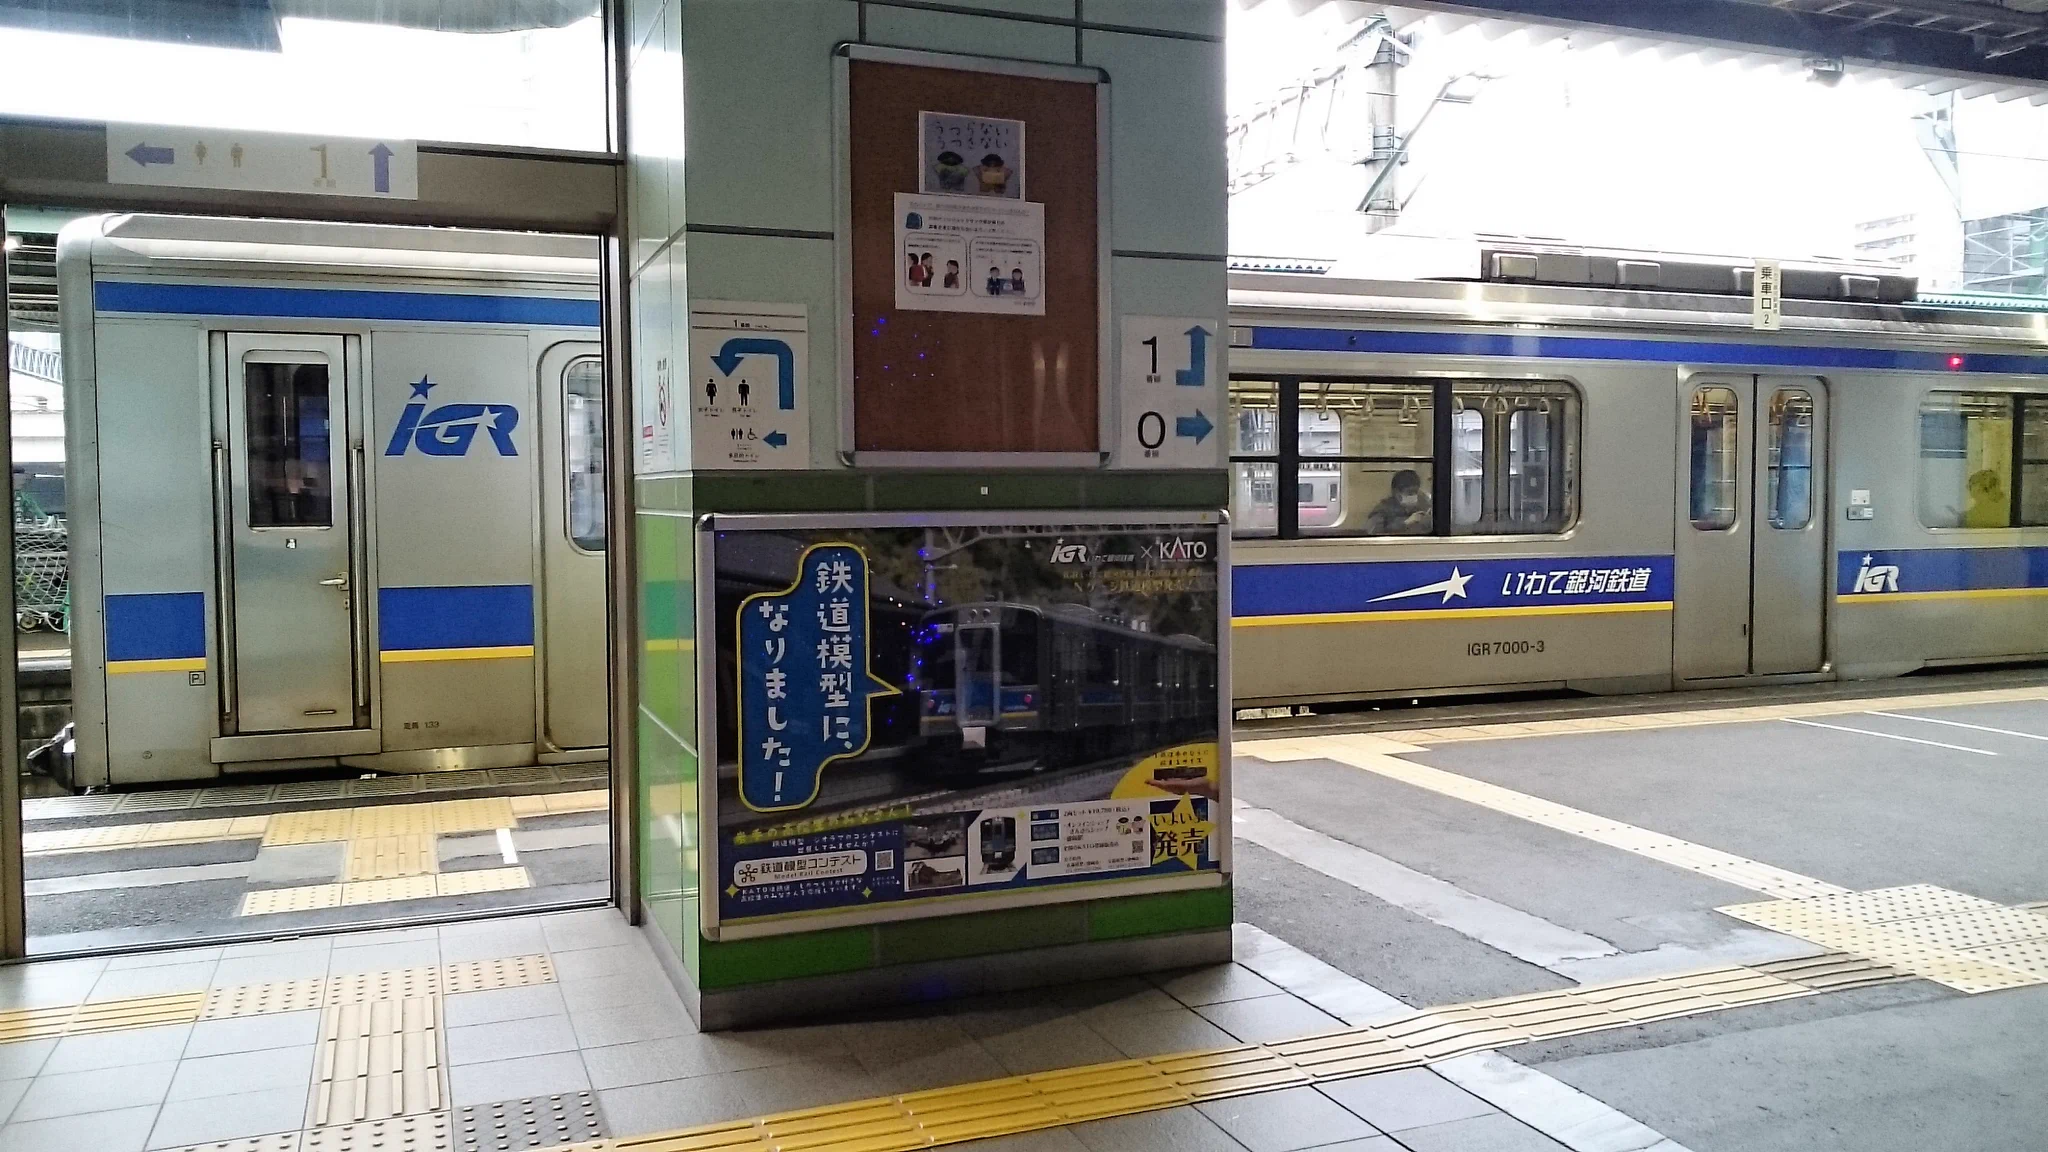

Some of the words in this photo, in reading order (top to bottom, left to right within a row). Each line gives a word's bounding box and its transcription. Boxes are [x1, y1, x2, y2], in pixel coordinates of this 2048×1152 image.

[309, 143, 327, 179] 1
[1761, 266, 1773, 309] 乗車口
[1142, 335, 1157, 374] 1
[1159, 536, 1207, 560] KATO
[1501, 567, 1652, 596] いわて銀河鉄道
[815, 560, 854, 750] 鉄道模型に、
[1467, 642, 1491, 657] IGR
[1493, 639, 1545, 655] 7000-3
[758, 600, 791, 802] なりました!
[1153, 811, 1206, 827] いよいよ
[1153, 827, 1206, 859] 発売
[760, 854, 861, 875] 鉄道模型コンテスト
[774, 872, 797, 880] Model
